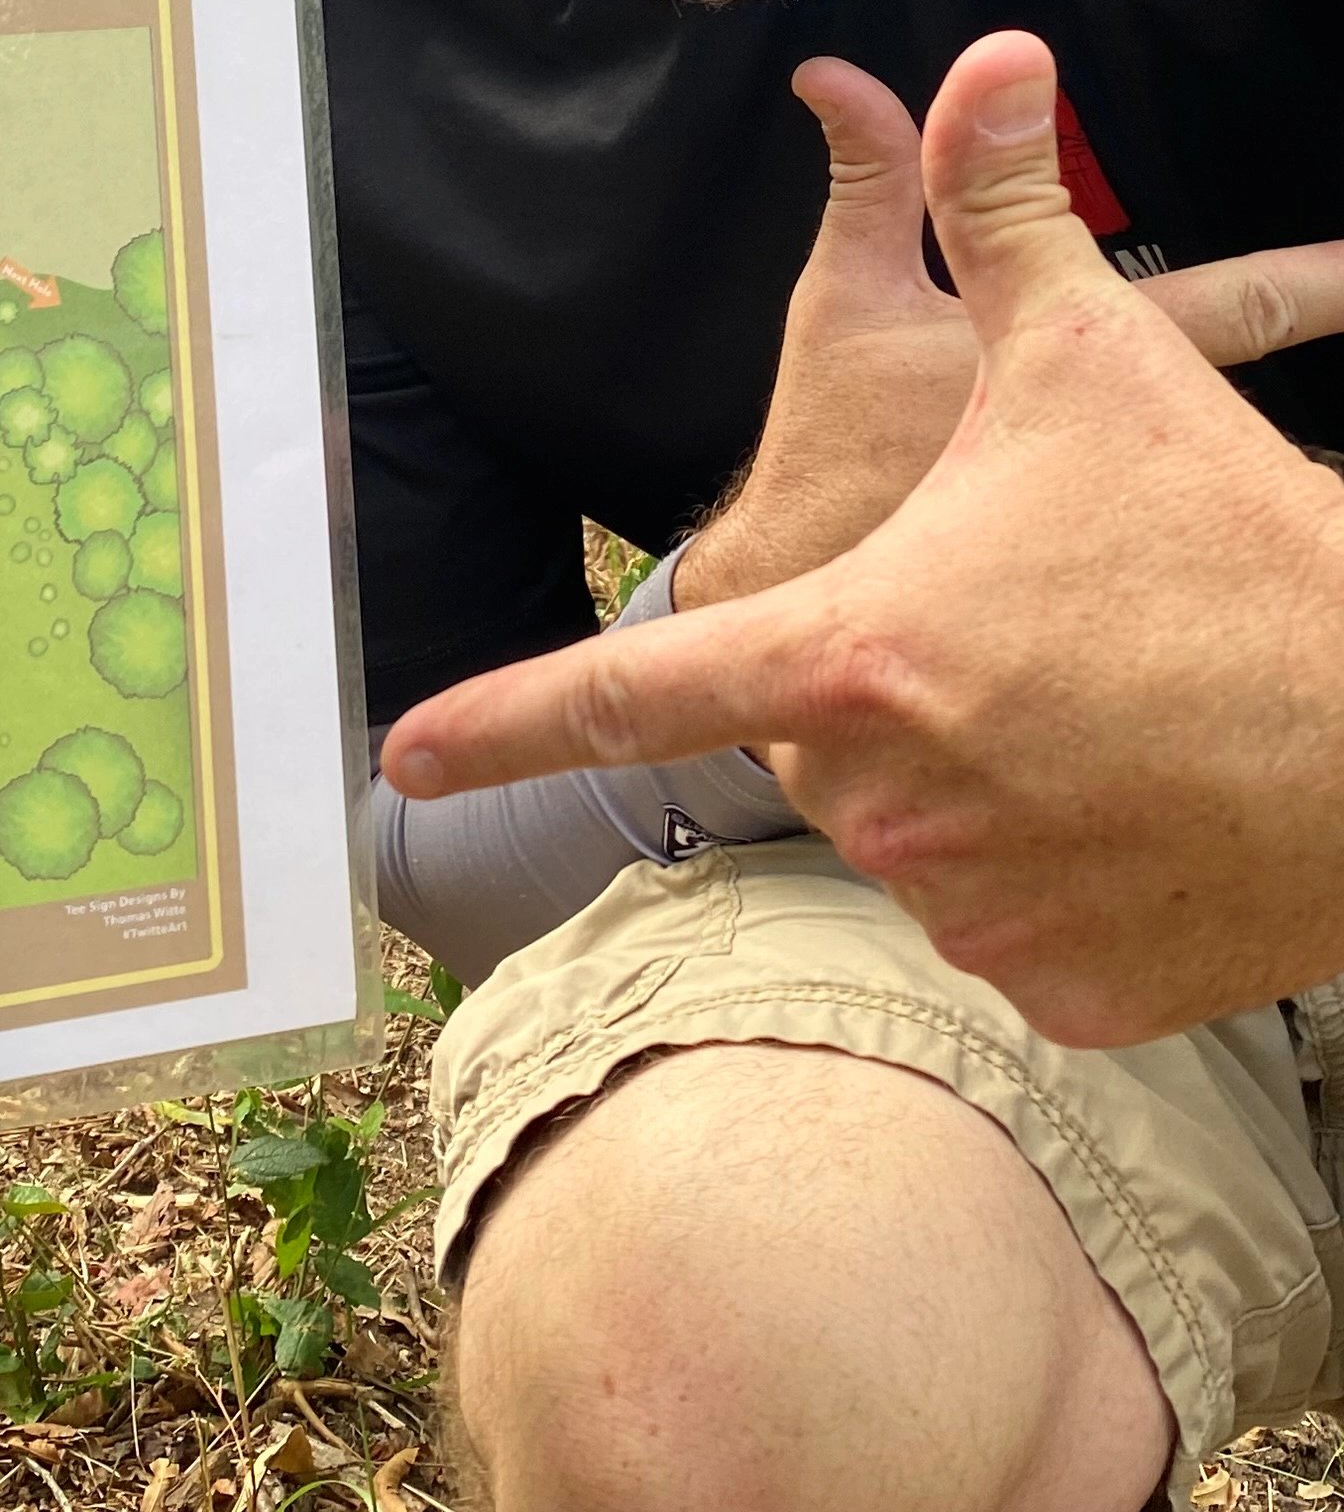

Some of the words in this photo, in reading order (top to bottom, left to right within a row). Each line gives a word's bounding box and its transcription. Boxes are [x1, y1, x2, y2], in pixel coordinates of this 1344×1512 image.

[64, 904, 87, 916] Tee
[89, 899, 117, 913] Sign
[119, 890, 168, 908] Designs
[170, 887, 186, 900] By
[103, 911, 152, 927] Thomas
